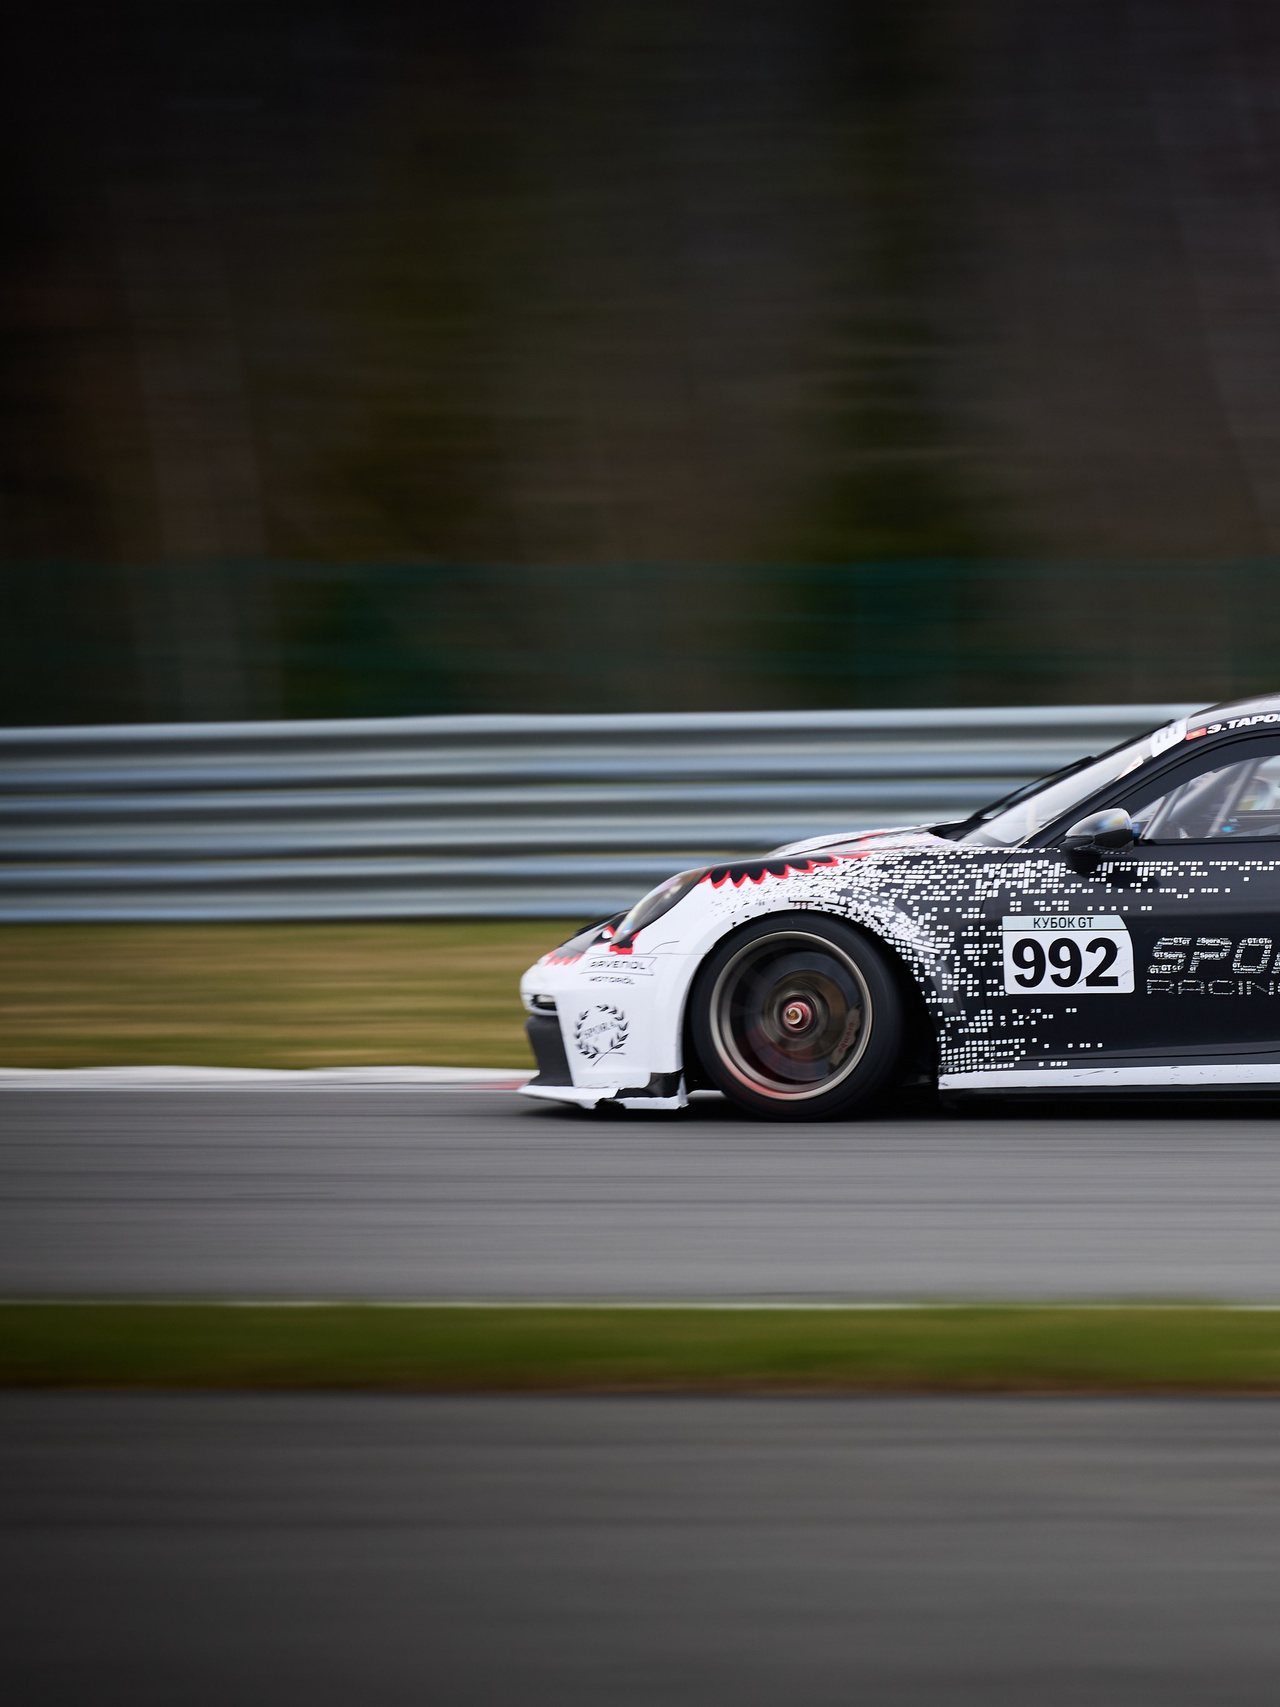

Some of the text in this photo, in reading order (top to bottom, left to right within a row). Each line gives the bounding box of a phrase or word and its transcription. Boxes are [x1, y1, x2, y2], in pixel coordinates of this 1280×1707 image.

[1033, 917, 1094, 929] КУБОК GT
[1011, 937, 1119, 988] 992
